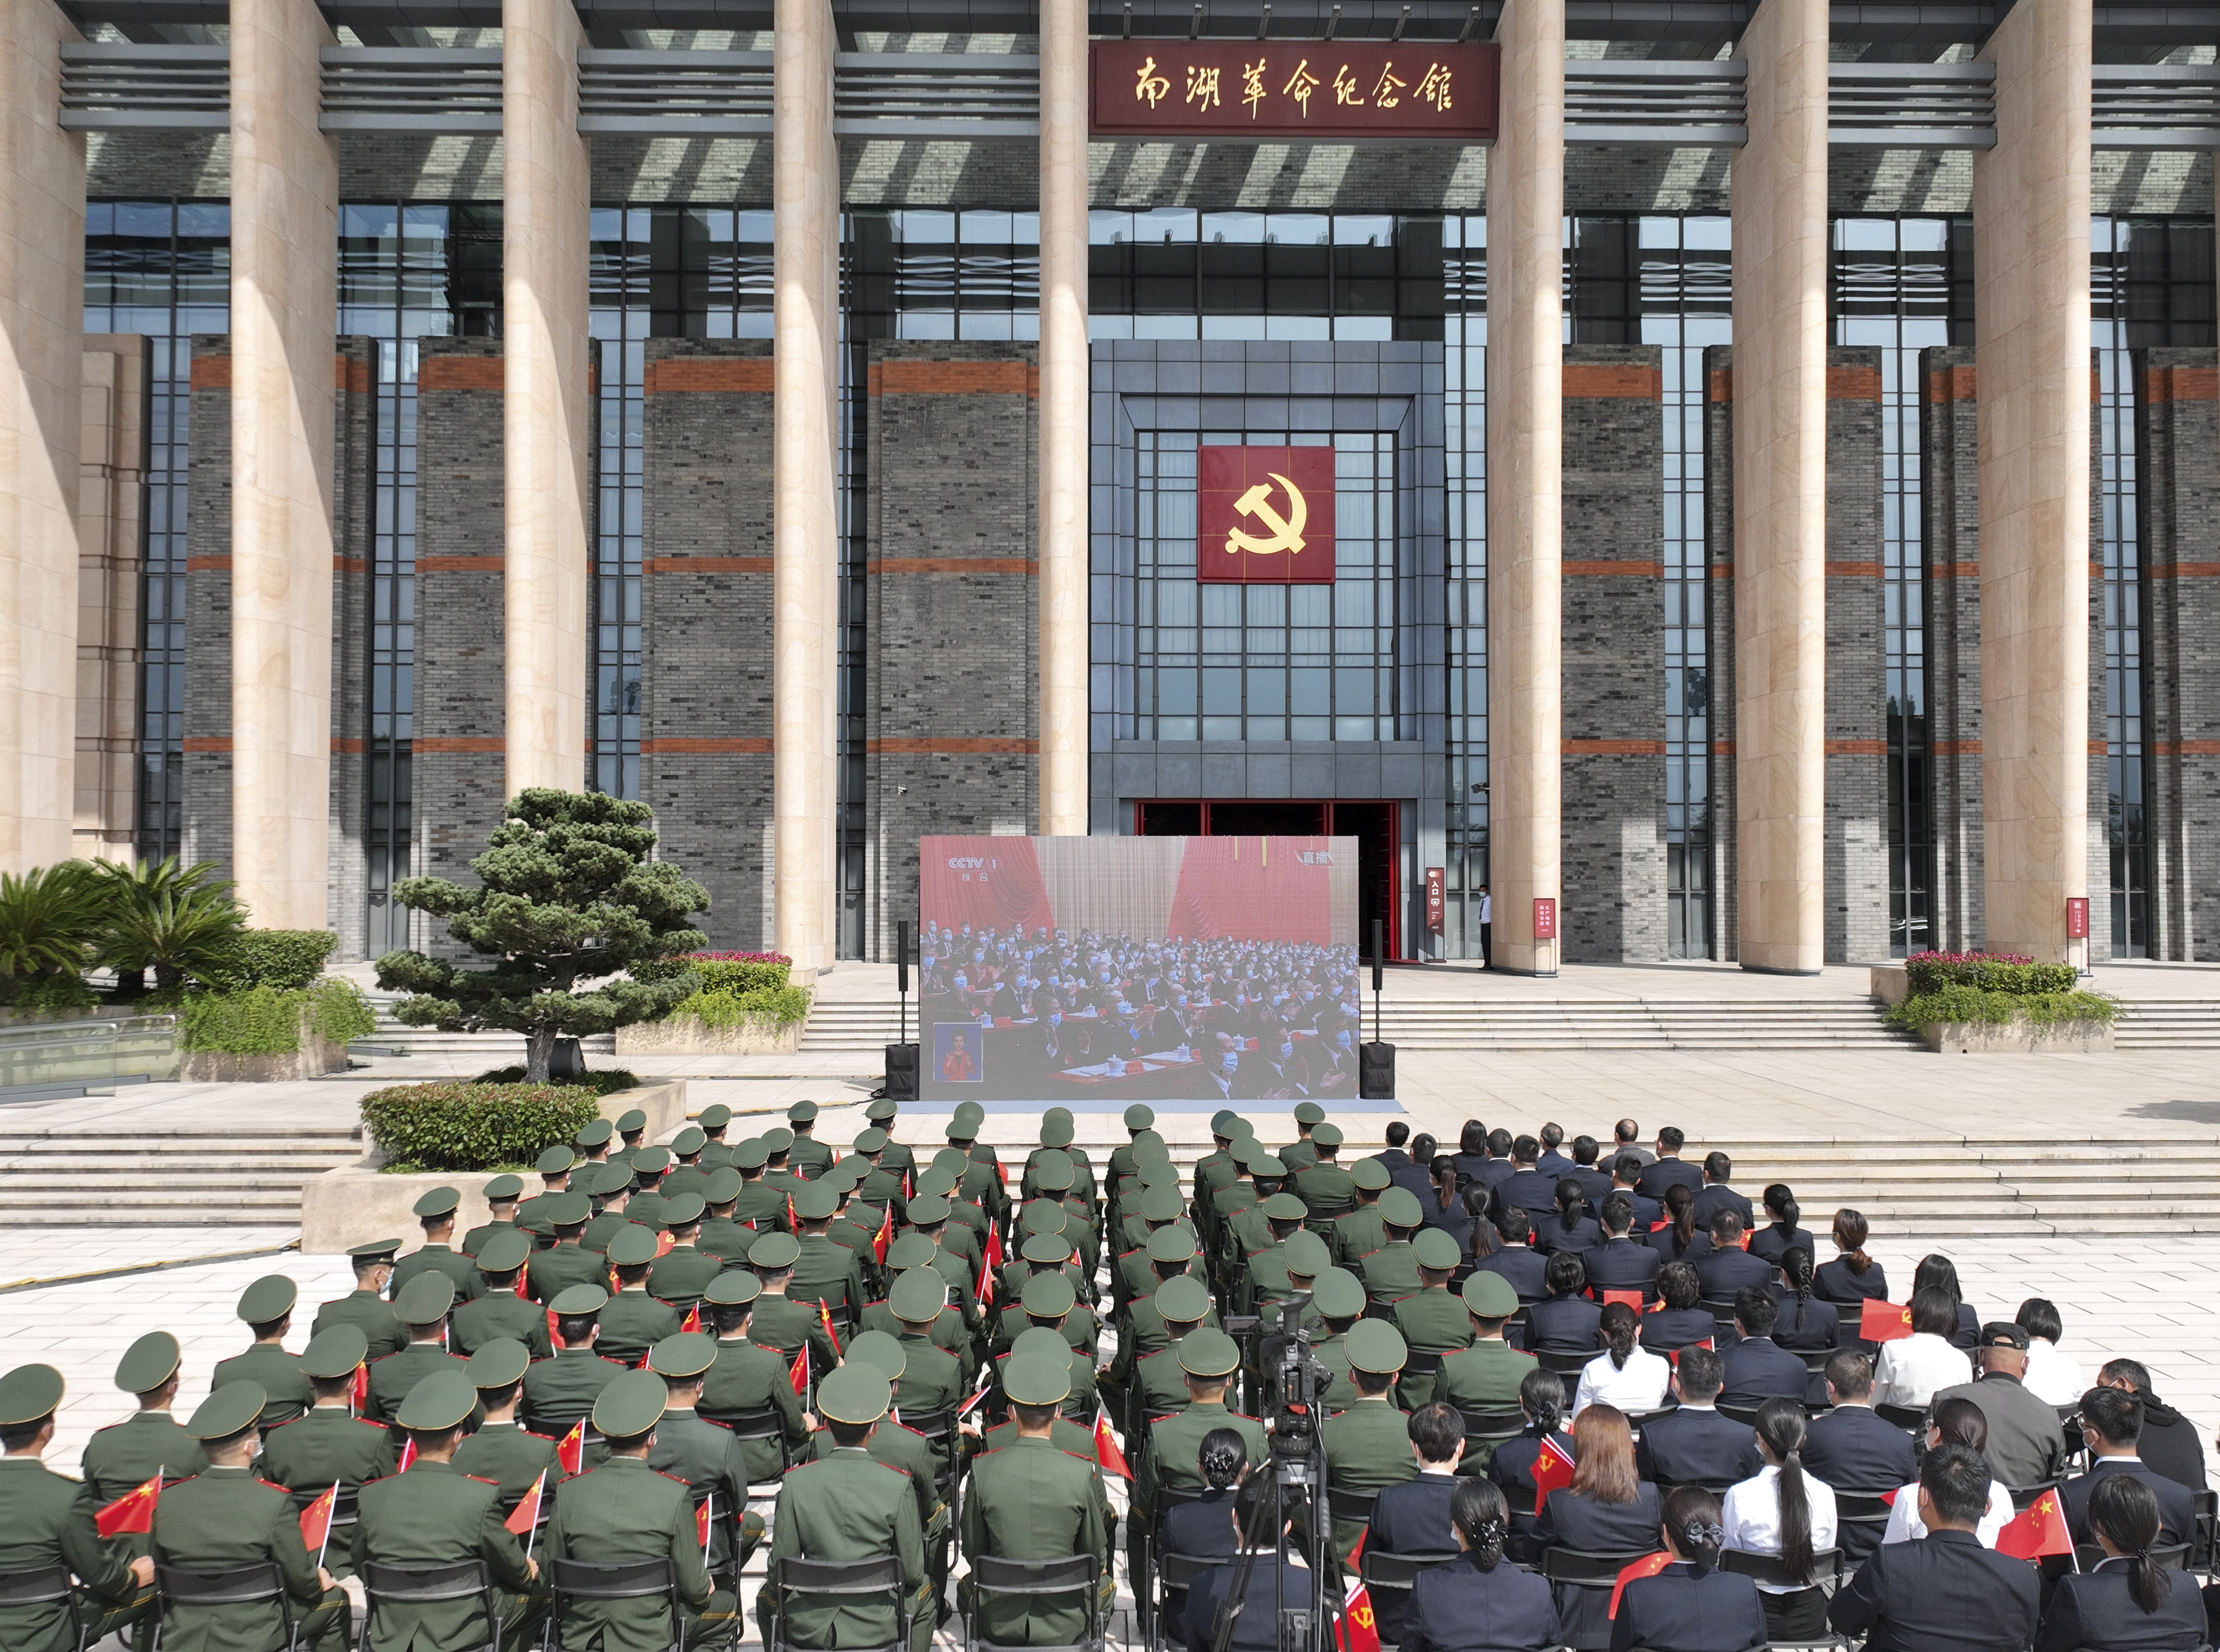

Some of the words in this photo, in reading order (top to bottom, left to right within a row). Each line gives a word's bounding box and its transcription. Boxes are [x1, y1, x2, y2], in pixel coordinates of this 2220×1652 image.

[949, 857, 984, 868] CCTV
[992, 859, 996, 869] 1
[1303, 851, 1328, 864] 直播
[962, 873, 988, 881] 综合
[1431, 880, 1439, 895] 入口
